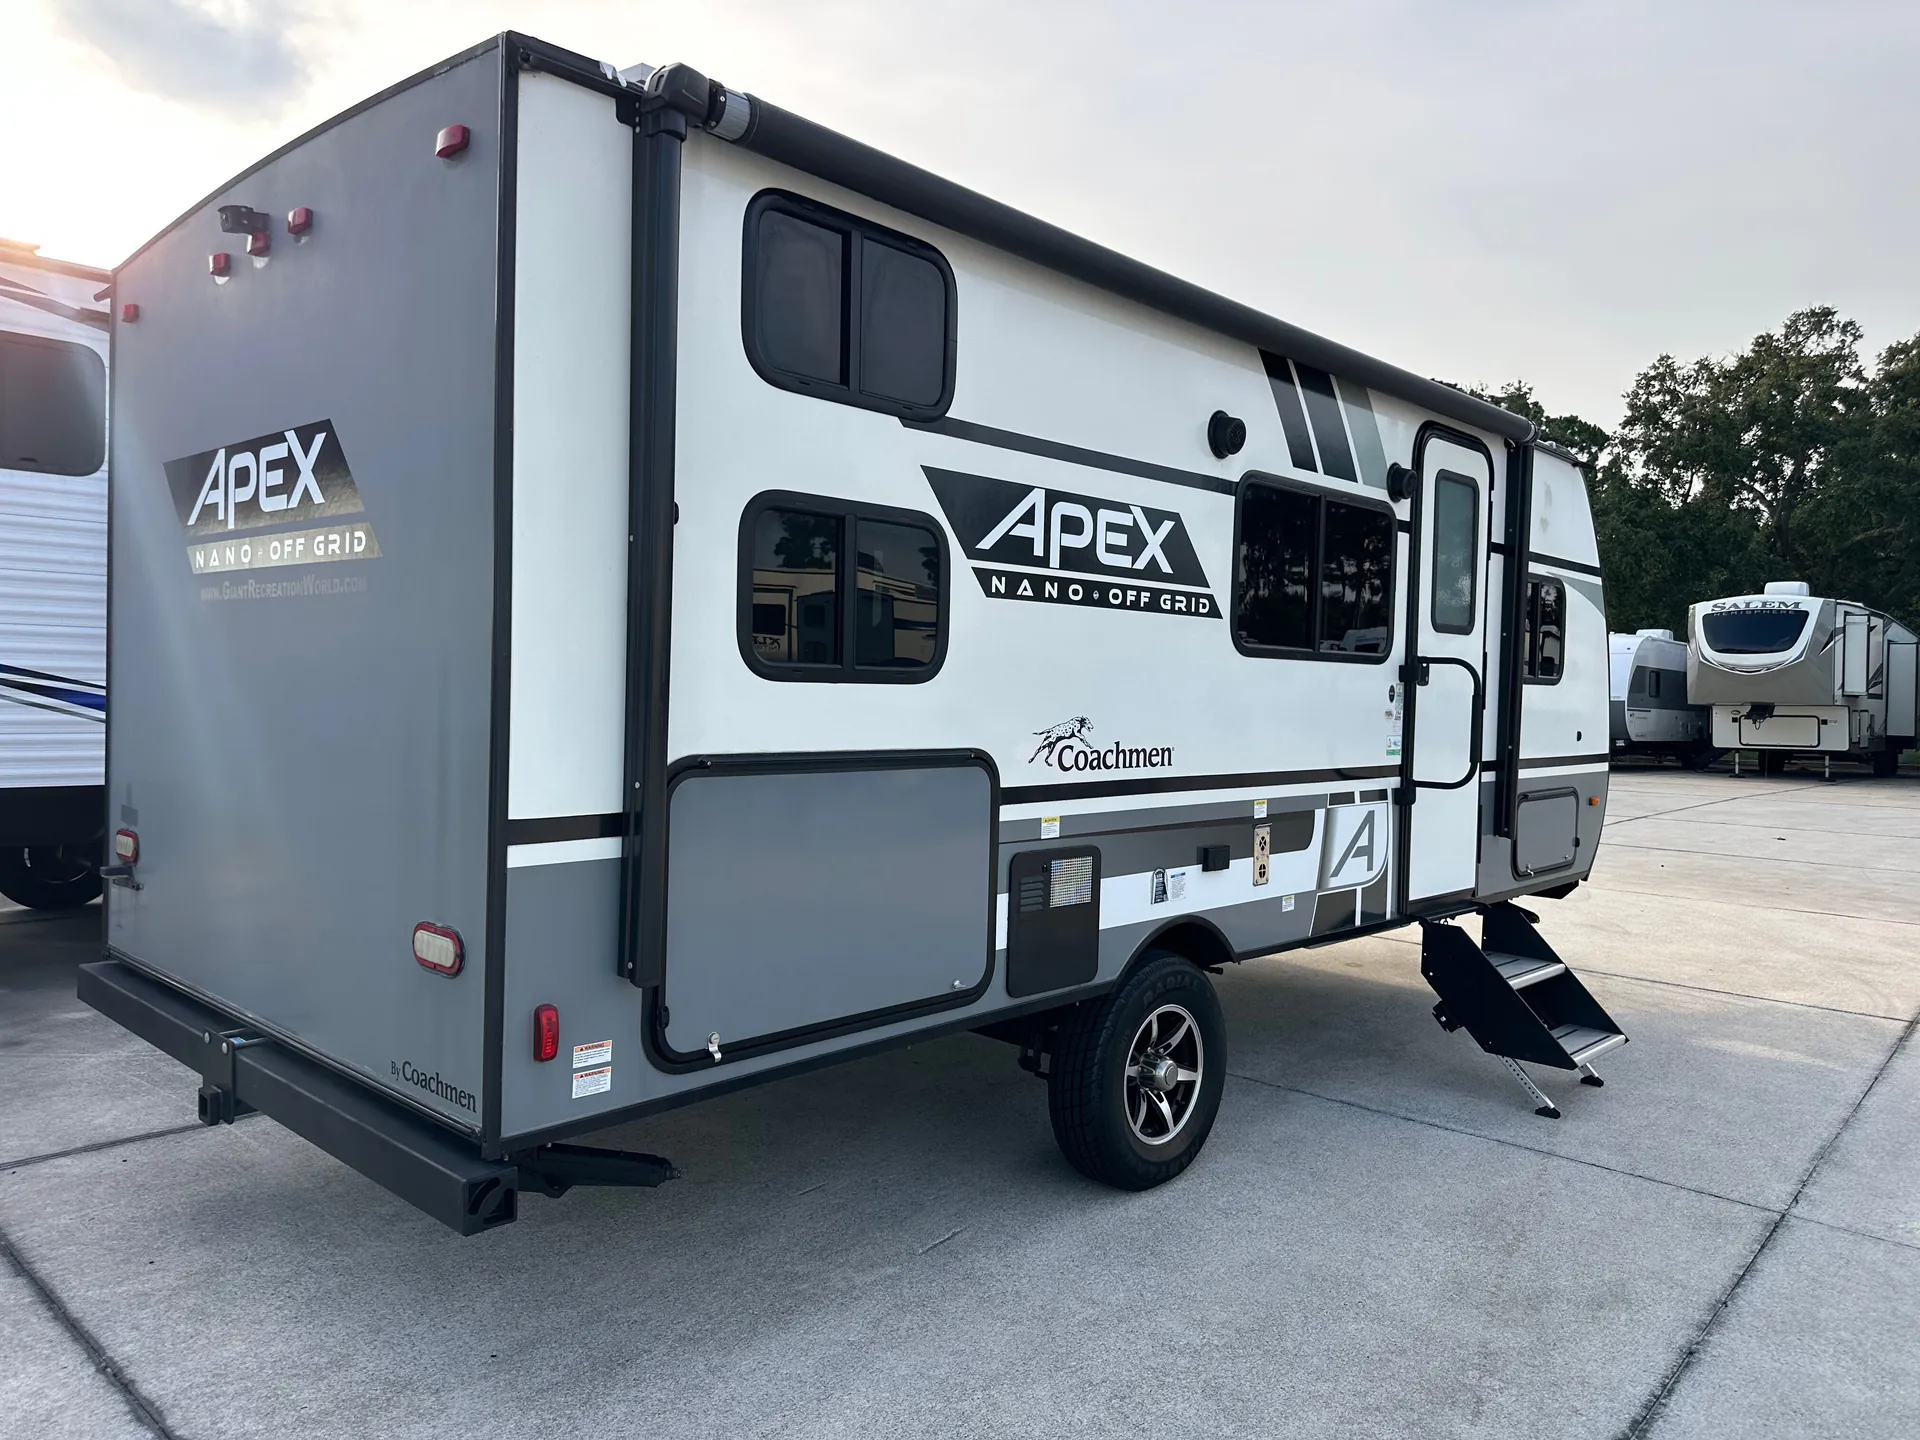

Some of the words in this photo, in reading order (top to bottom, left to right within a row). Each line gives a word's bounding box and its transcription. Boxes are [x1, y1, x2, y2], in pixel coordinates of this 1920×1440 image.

[187, 429, 327, 529] APEX
[196, 544, 251, 568] NANO
[269, 538, 305, 560] OFF
[313, 531, 366, 556] GRID
[975, 488, 1175, 574] APEX
[991, 575, 1083, 601] NANO
[1109, 588, 1150, 607] OFF
[1160, 594, 1210, 614] GRID
[1711, 601, 1802, 612] SALEM
[1057, 741, 1173, 772] Coachmen
[1330, 810, 1375, 877] A
[391, 1061, 401, 1080] By
[402, 1061, 477, 1113] Coachmen
